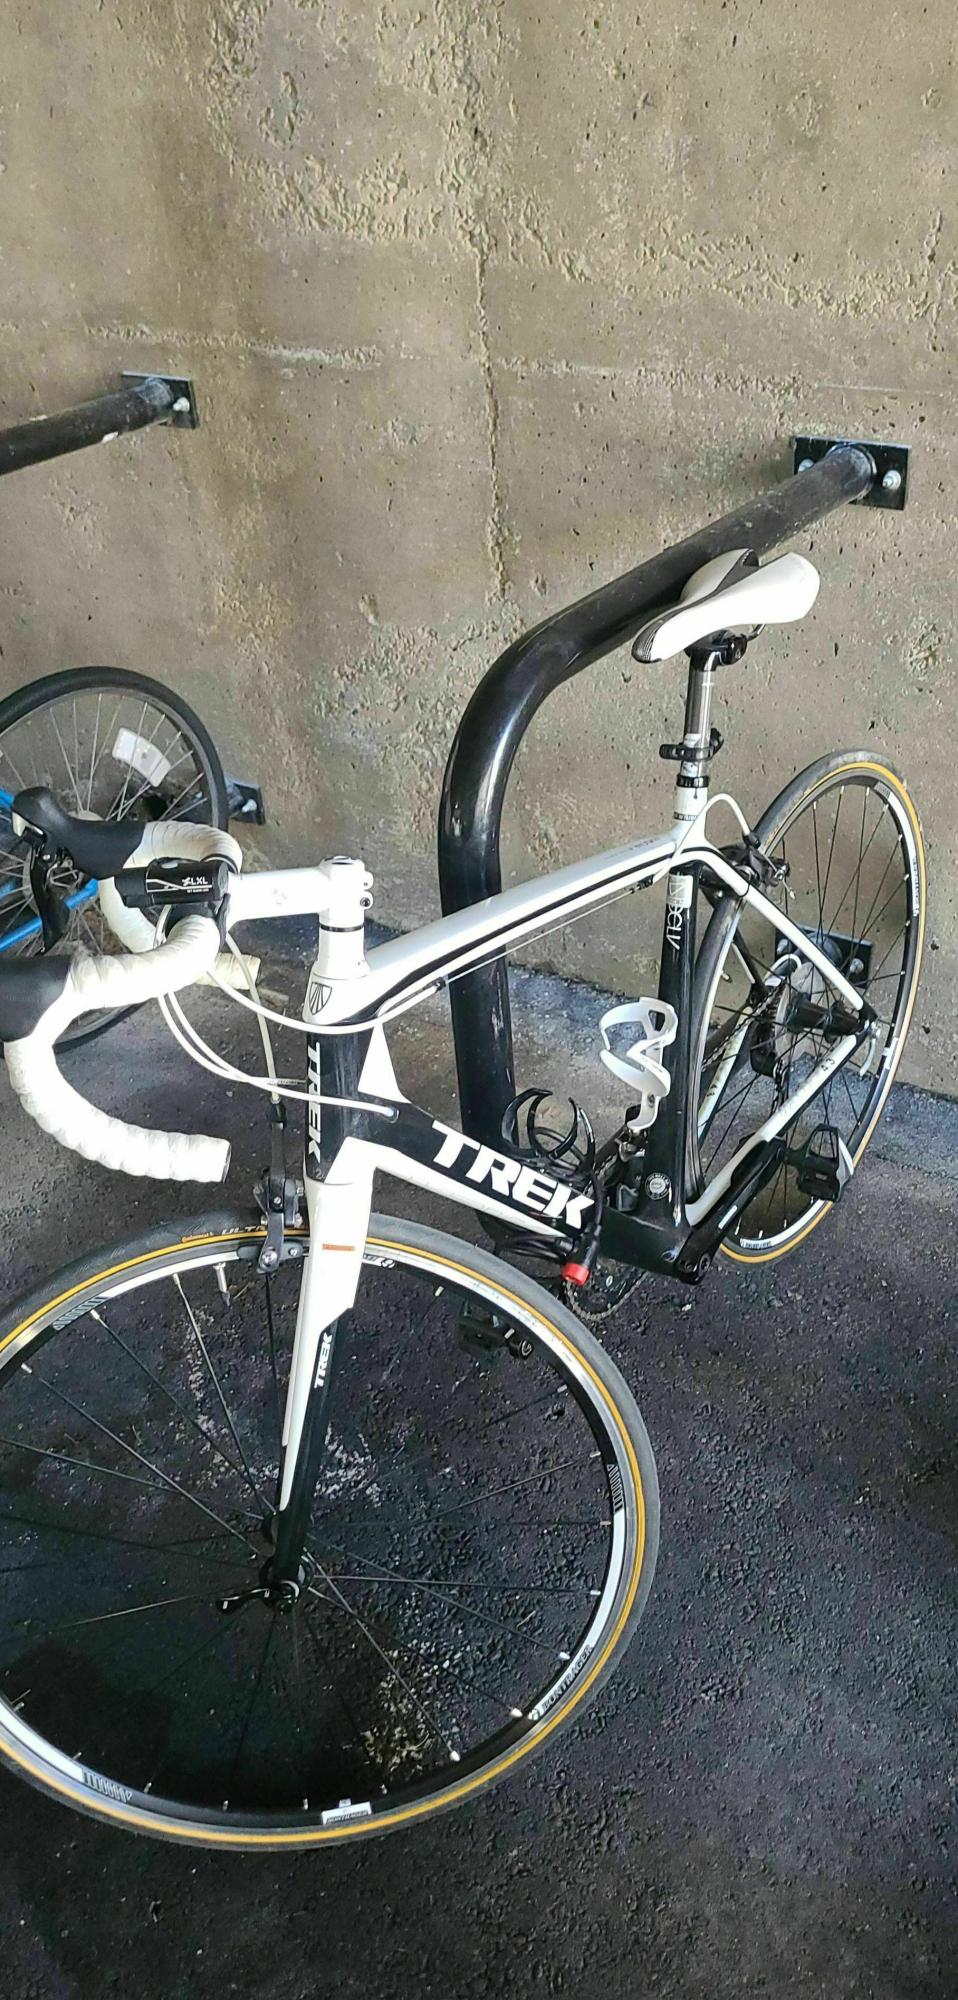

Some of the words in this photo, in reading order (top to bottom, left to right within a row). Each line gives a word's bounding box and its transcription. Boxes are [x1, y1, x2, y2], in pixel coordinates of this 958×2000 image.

[308, 1042, 320, 1163] TREK
[432, 1120, 595, 1229] TREK
[314, 1332, 333, 1389] TREK
